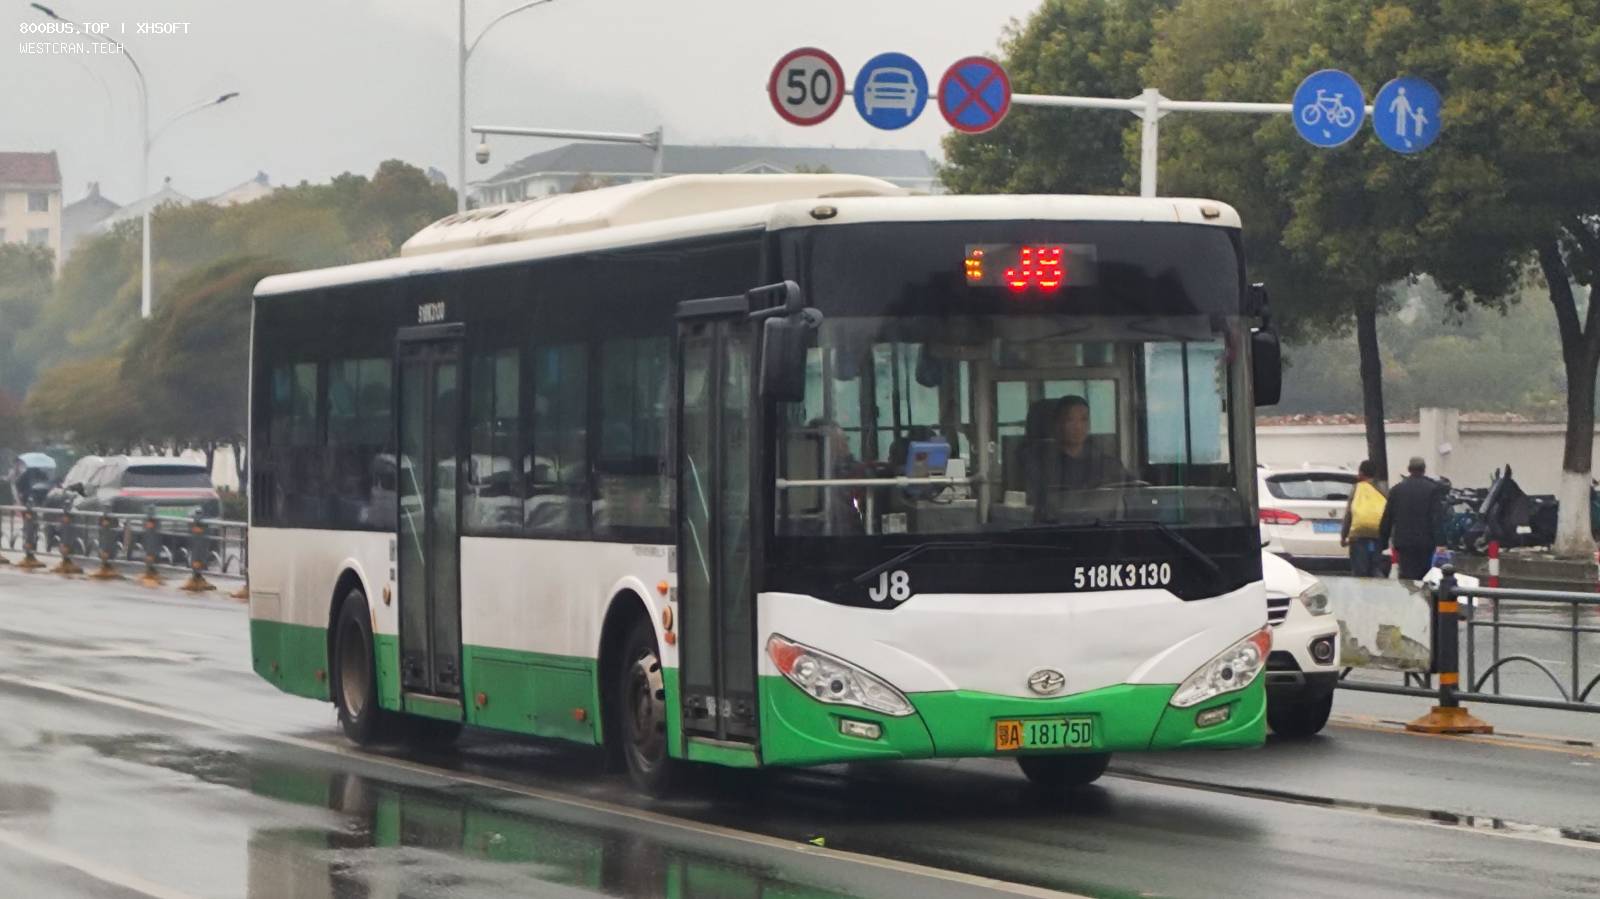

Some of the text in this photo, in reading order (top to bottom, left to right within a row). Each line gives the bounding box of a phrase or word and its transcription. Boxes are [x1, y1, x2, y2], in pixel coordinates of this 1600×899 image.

[787, 68, 831, 105] 50
[870, 570, 910, 602] J8
[1074, 563, 1171, 588] 518K3130
[1030, 722, 1091, 745] 18175D
